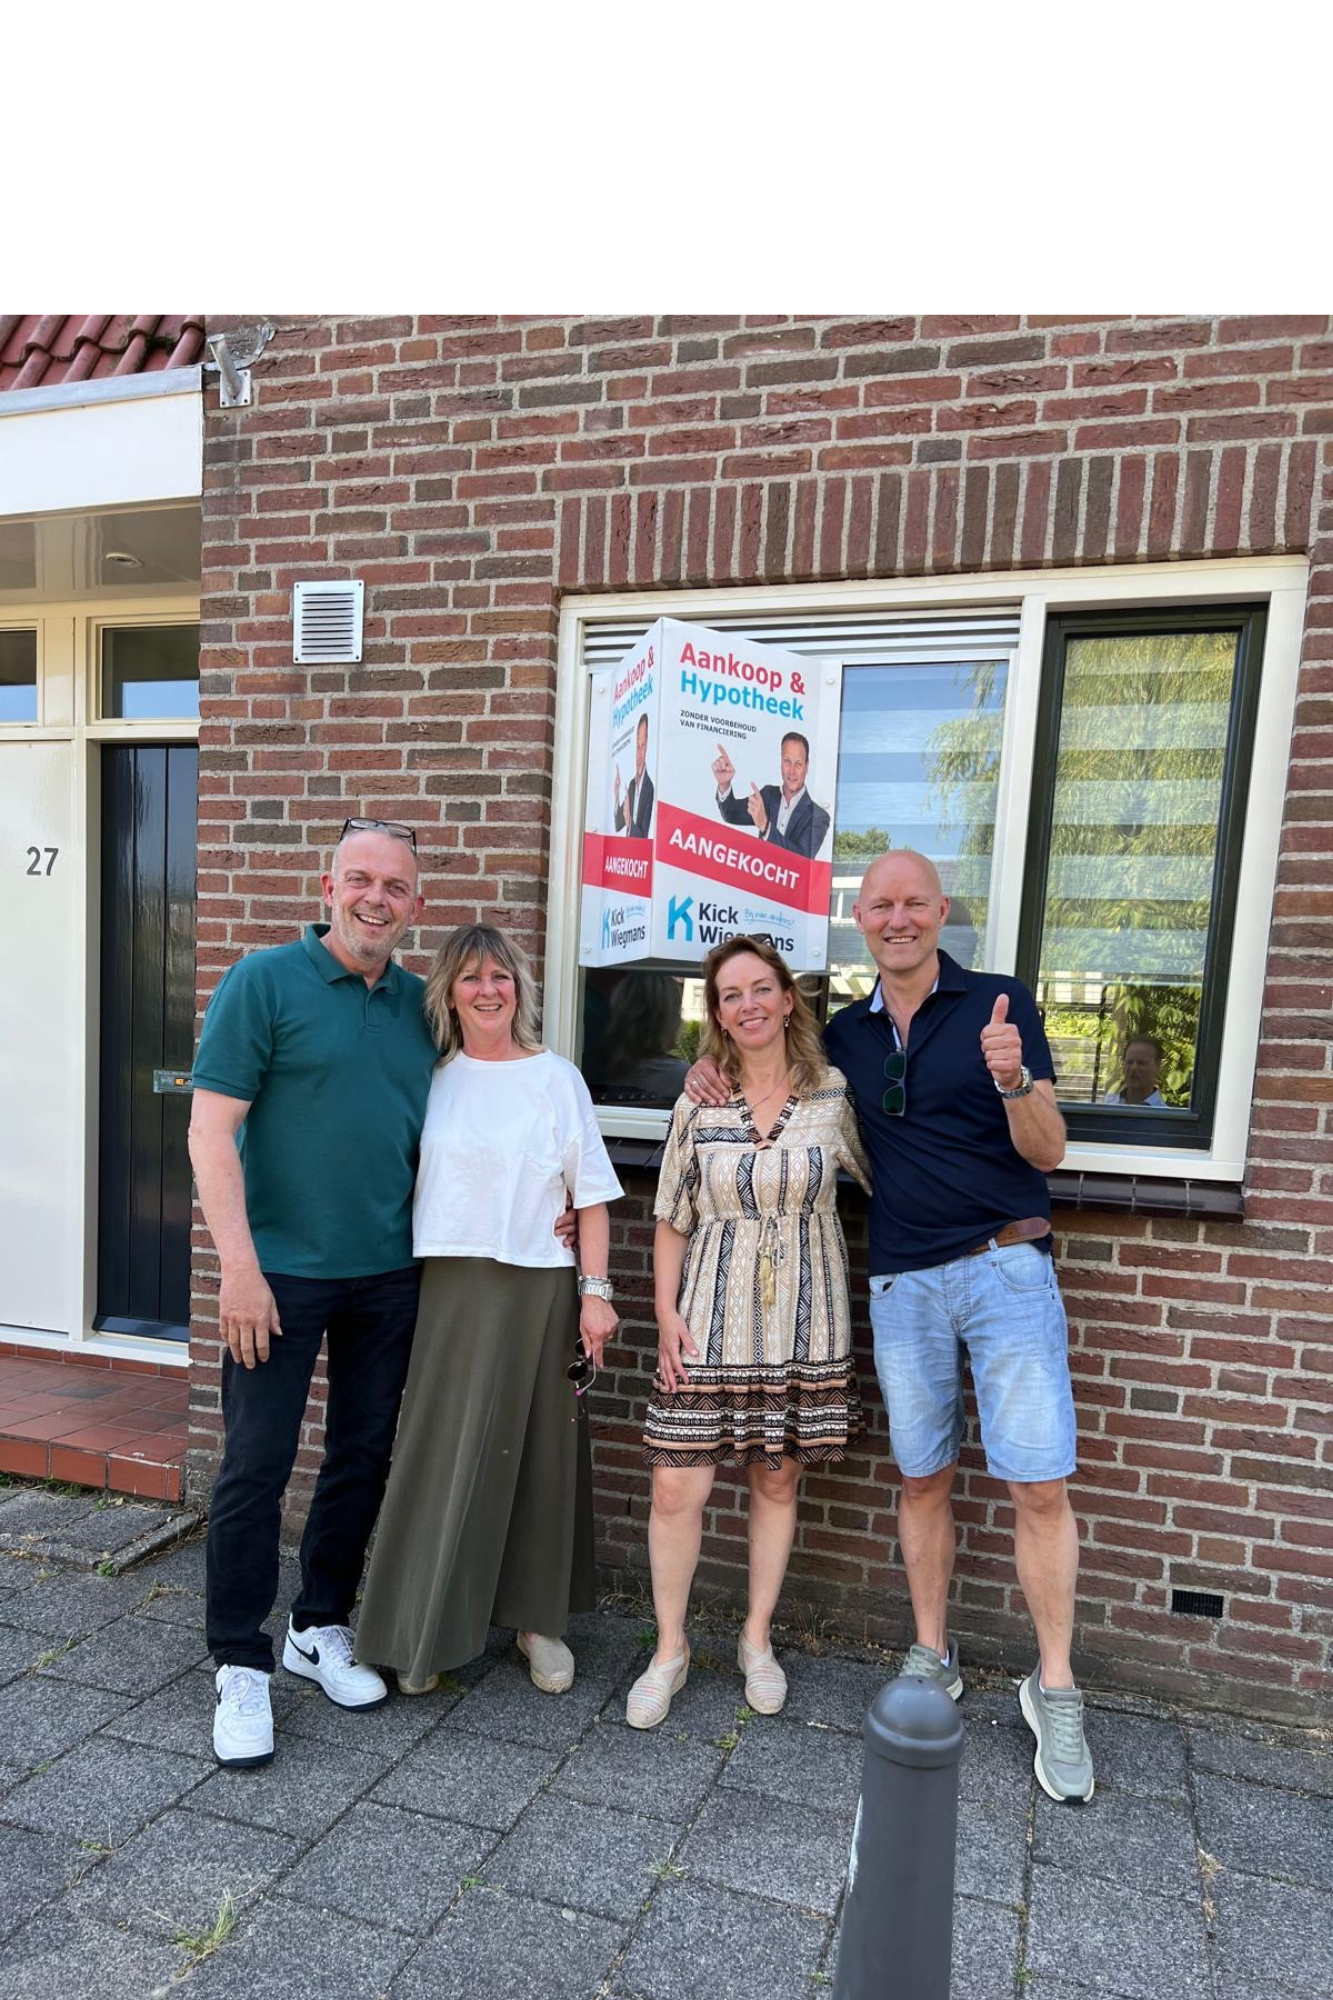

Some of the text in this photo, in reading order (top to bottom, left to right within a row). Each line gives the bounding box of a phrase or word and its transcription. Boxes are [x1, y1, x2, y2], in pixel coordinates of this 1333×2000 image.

[613, 658, 646, 704] Aankoop
[647, 645, 655, 668] &
[680, 642, 806, 695] Aankoop &
[612, 673, 654, 729] Hypotheek
[680, 670, 804, 721] Hypotheek
[680, 709, 757, 733] ZONDER VOORBEHOUD
[680, 719, 747, 740] VAN FINANCIERING
[26, 846, 60, 876] 27
[604, 855, 649, 879] AANGEKOCHT
[669, 828, 800, 889] AANGEKOCHT
[611, 907, 625, 927] Kick
[699, 902, 739, 925] Kick
[611, 925, 646, 949] Wiegmans
